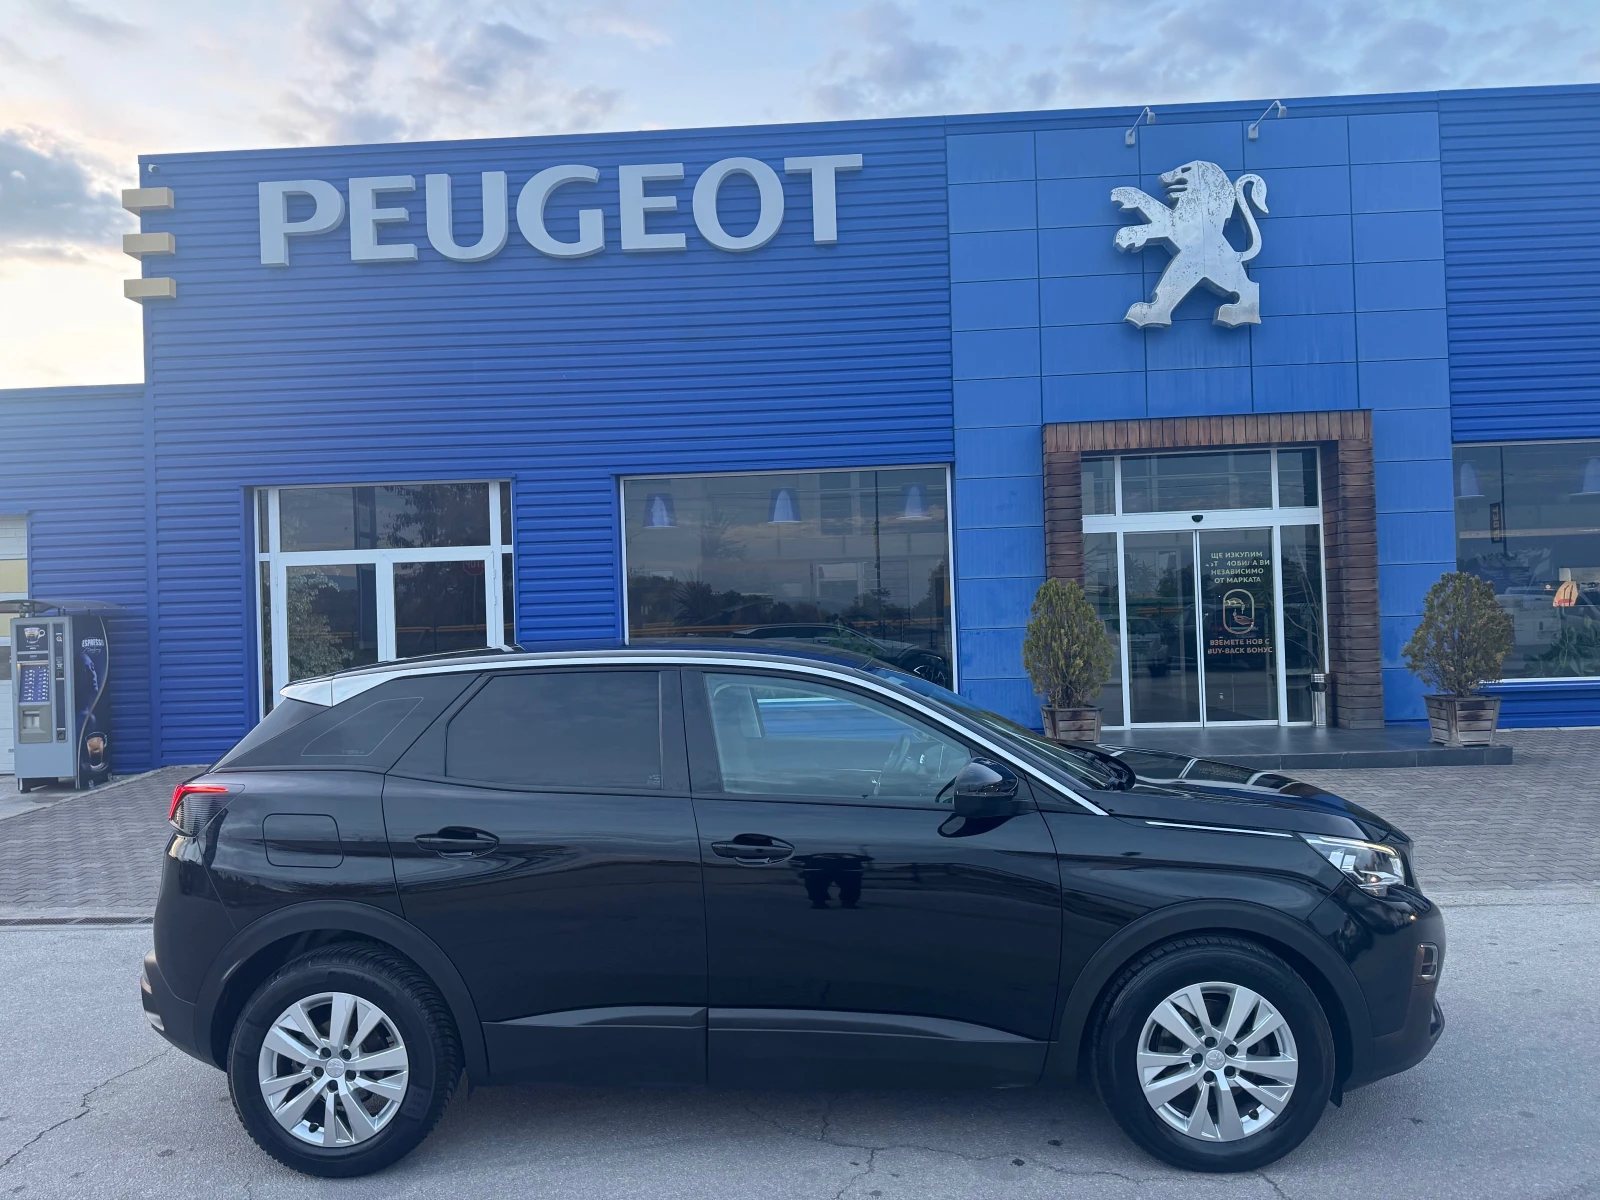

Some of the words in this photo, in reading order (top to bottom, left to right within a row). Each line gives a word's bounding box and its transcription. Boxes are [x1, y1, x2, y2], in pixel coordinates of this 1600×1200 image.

[258, 154, 862, 267] PEUGEOT
[1226, 576, 1262, 584] МАРКАТА
[1246, 646, 1273, 654] БОНУС
